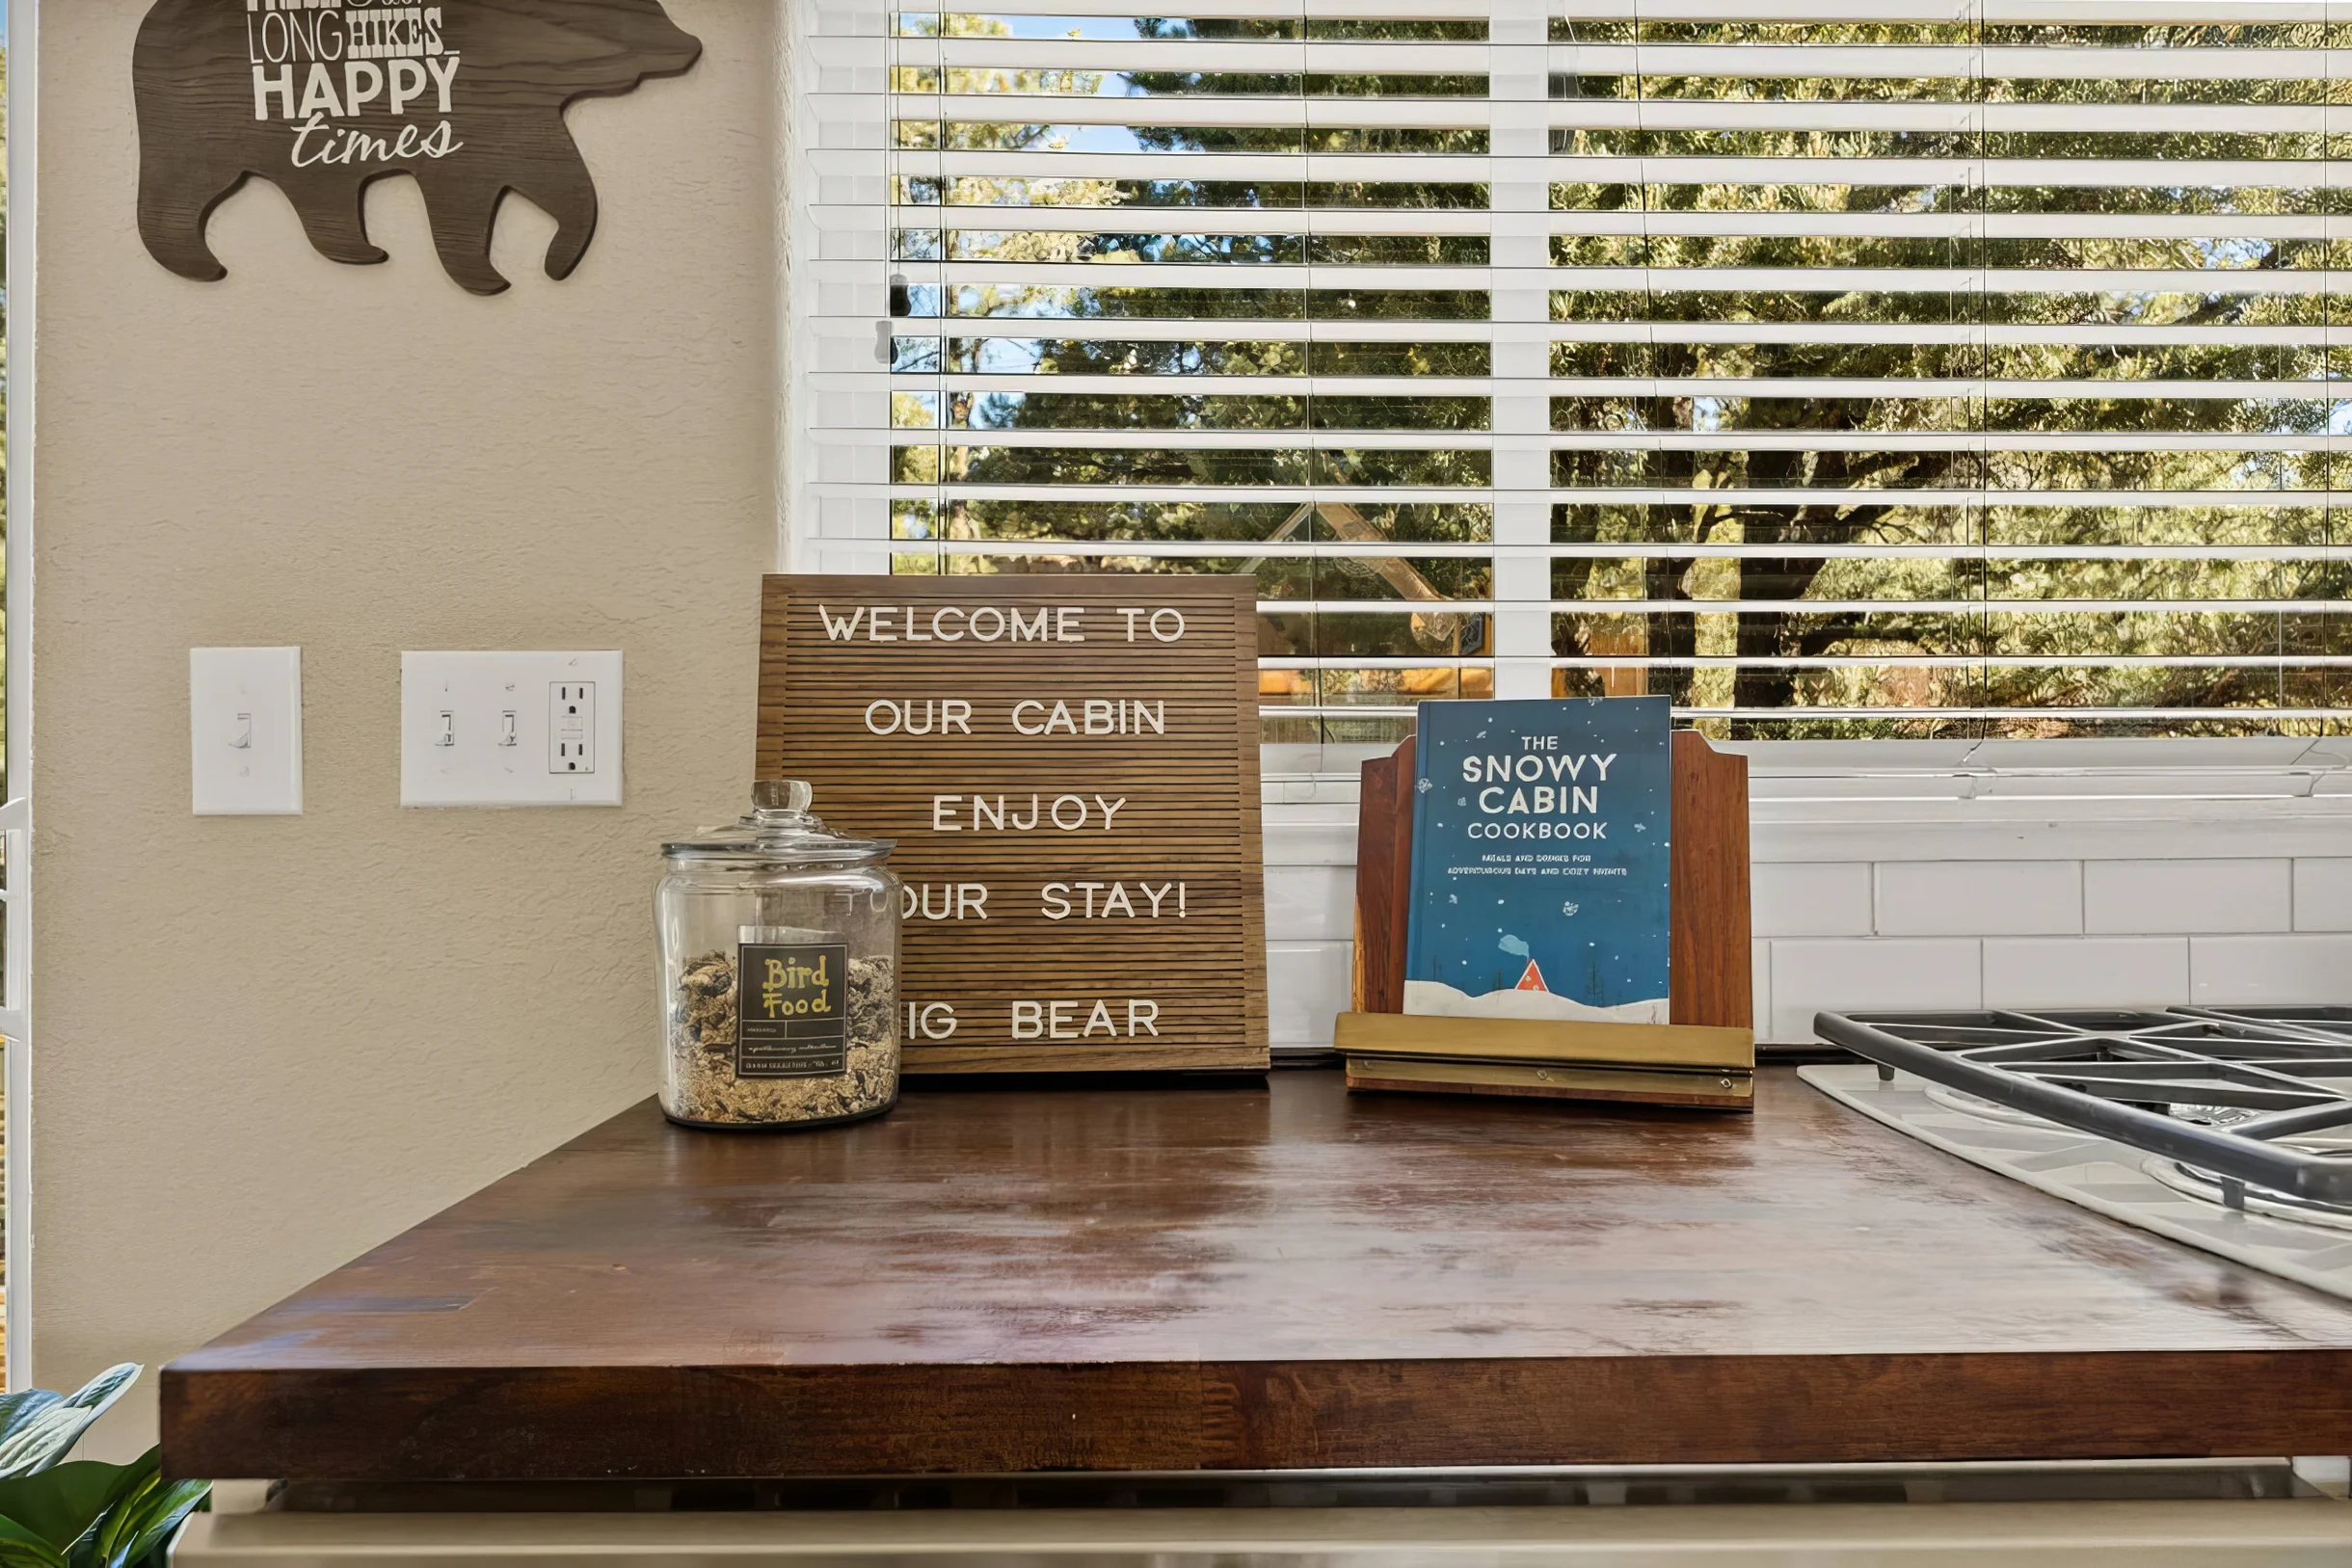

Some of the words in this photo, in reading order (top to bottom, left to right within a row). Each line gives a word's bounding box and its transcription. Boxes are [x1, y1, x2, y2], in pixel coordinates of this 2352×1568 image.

[247, 10, 343, 64] LONG
[345, 7, 444, 59] HIKES
[253, 57, 460, 120] HAPPY
[290, 112, 464, 168] times
[818, 604, 1084, 643] WELCOME
[1116, 608, 1185, 642] TO
[865, 700, 972, 735] OUR
[1011, 700, 1164, 735] CABIN
[1521, 735, 1559, 751] THE
[1462, 753, 1617, 783] SNOWY
[933, 794, 1127, 831] ENJOY
[1479, 785, 1597, 814] CABIN
[1467, 821, 1608, 839] COOKBOOK
[1040, 881, 1187, 920] STAY!
[762, 955, 830, 992] Bird
[762, 989, 832, 1019] Food
[908, 1001, 958, 1040] IG
[1011, 998, 1160, 1040] BEAR
